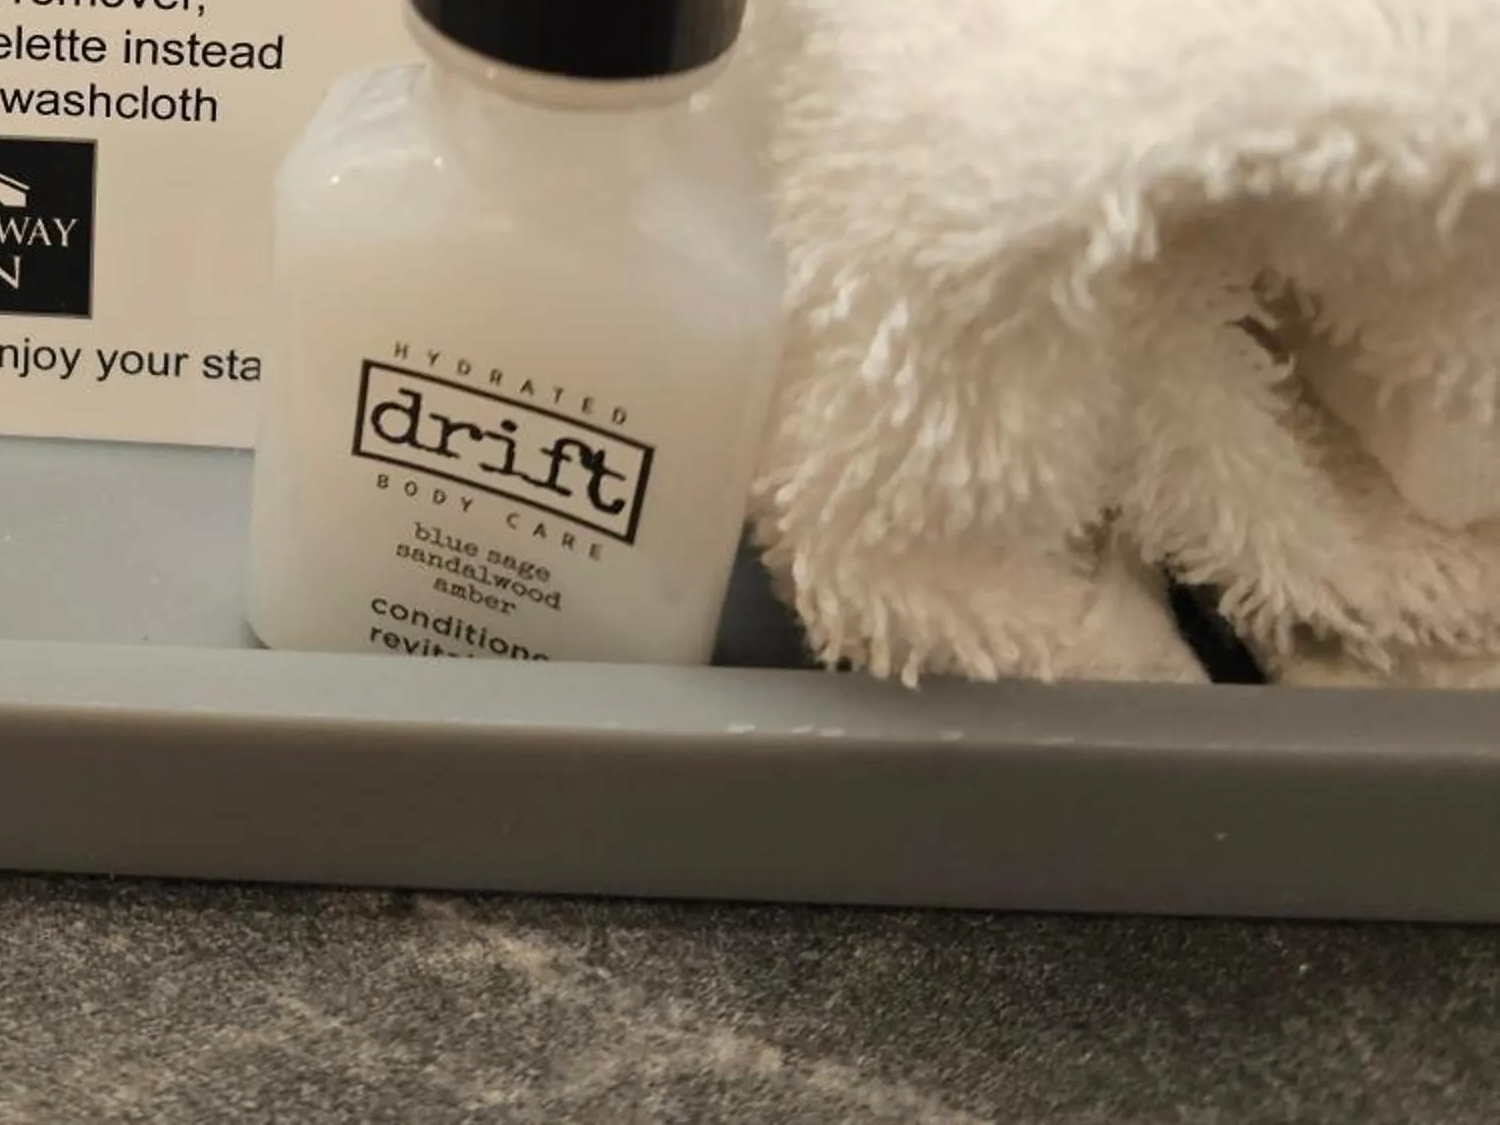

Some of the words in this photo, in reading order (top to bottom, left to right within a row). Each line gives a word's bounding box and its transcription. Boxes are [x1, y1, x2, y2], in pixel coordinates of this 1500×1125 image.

[123, 28, 284, 70] instead
[0, 83, 219, 122] washcloth
[97, 345, 188, 381] your
[203, 349, 260, 381] sta
[393, 341, 629, 426] HYDRATED
[371, 387, 627, 515] drift
[376, 474, 475, 513] BODY
[506, 512, 603, 561] CARE
[396, 541, 563, 611] sandalwood
[414, 522, 479, 557] blue
[486, 547, 552, 583] sage
[433, 577, 517, 616] amber
[371, 598, 550, 661] condition
